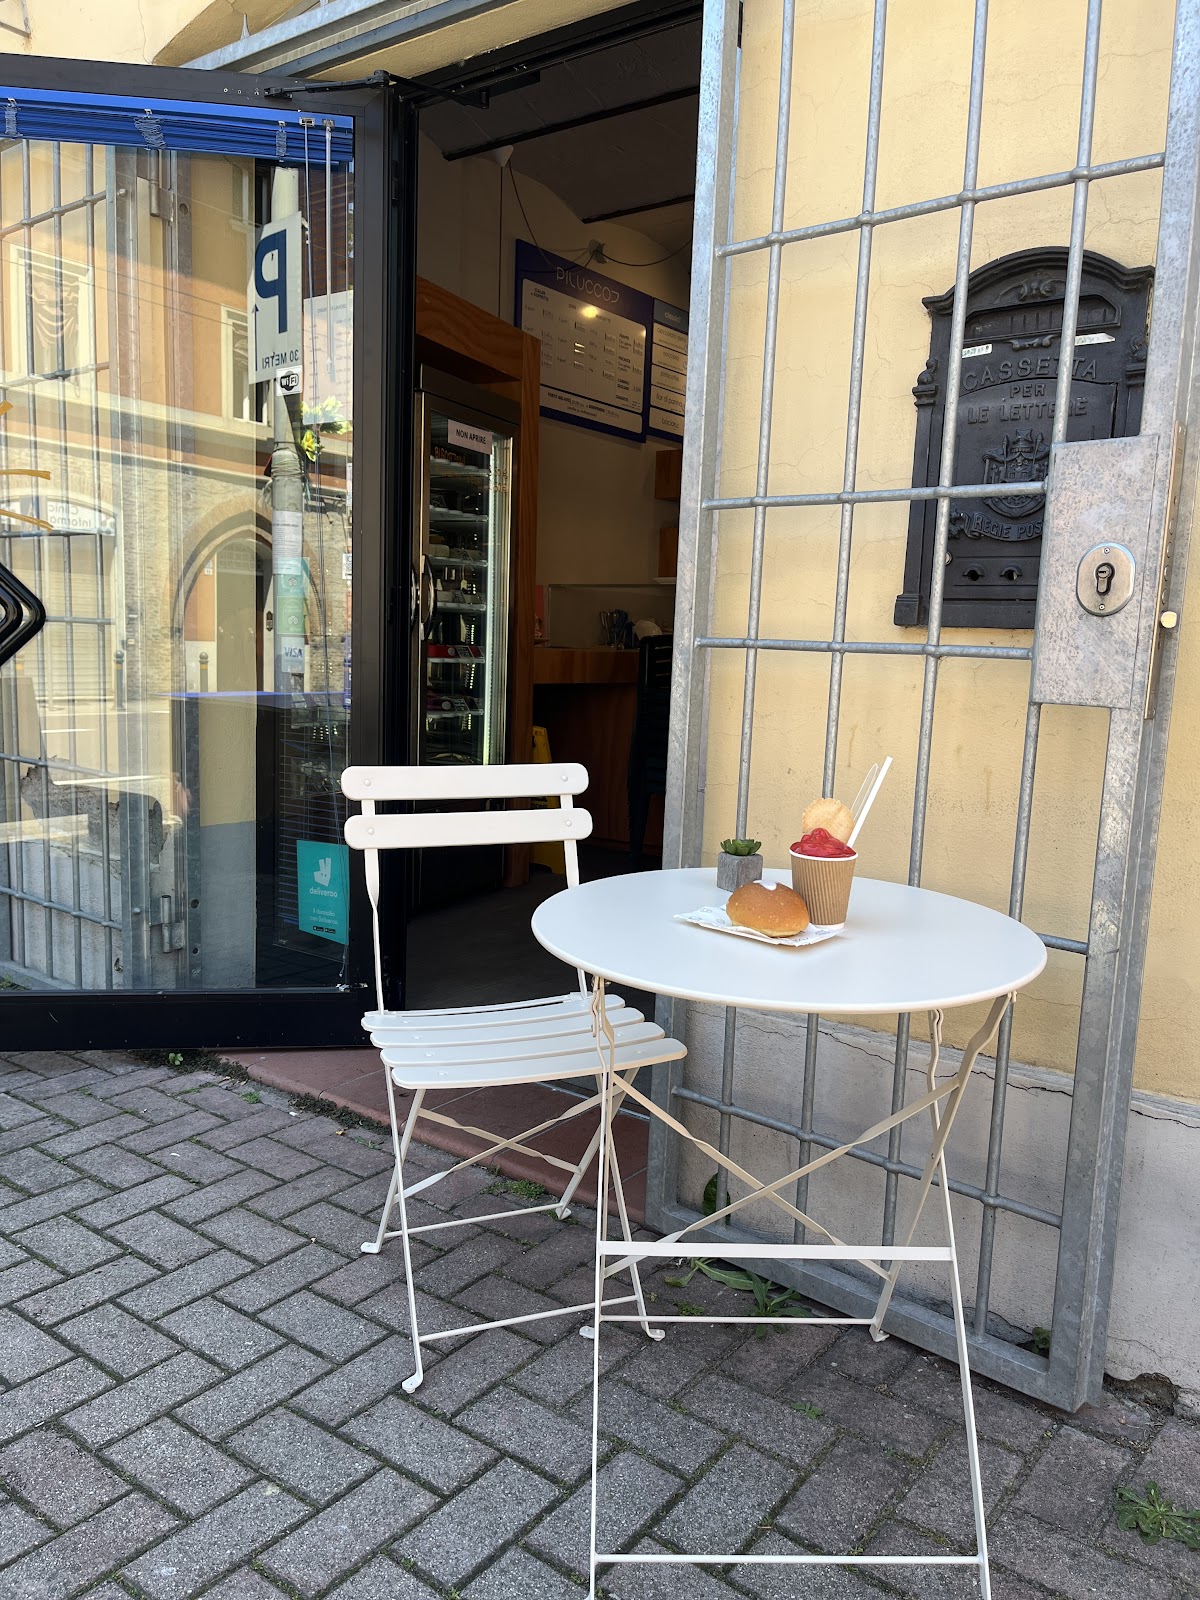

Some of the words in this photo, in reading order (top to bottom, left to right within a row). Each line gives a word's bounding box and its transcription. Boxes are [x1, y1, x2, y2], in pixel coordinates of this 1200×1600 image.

[1009, 383, 1047, 398] PER
[967, 405, 990, 424] LE
[456, 429, 469, 440] NON
[469, 433, 486, 445] APRIRE
[973, 512, 1012, 539] REGIE
[1017, 520, 1043, 539] POS
[283, 647, 303, 658] VISA
[309, 886, 338, 898] deliveroo
